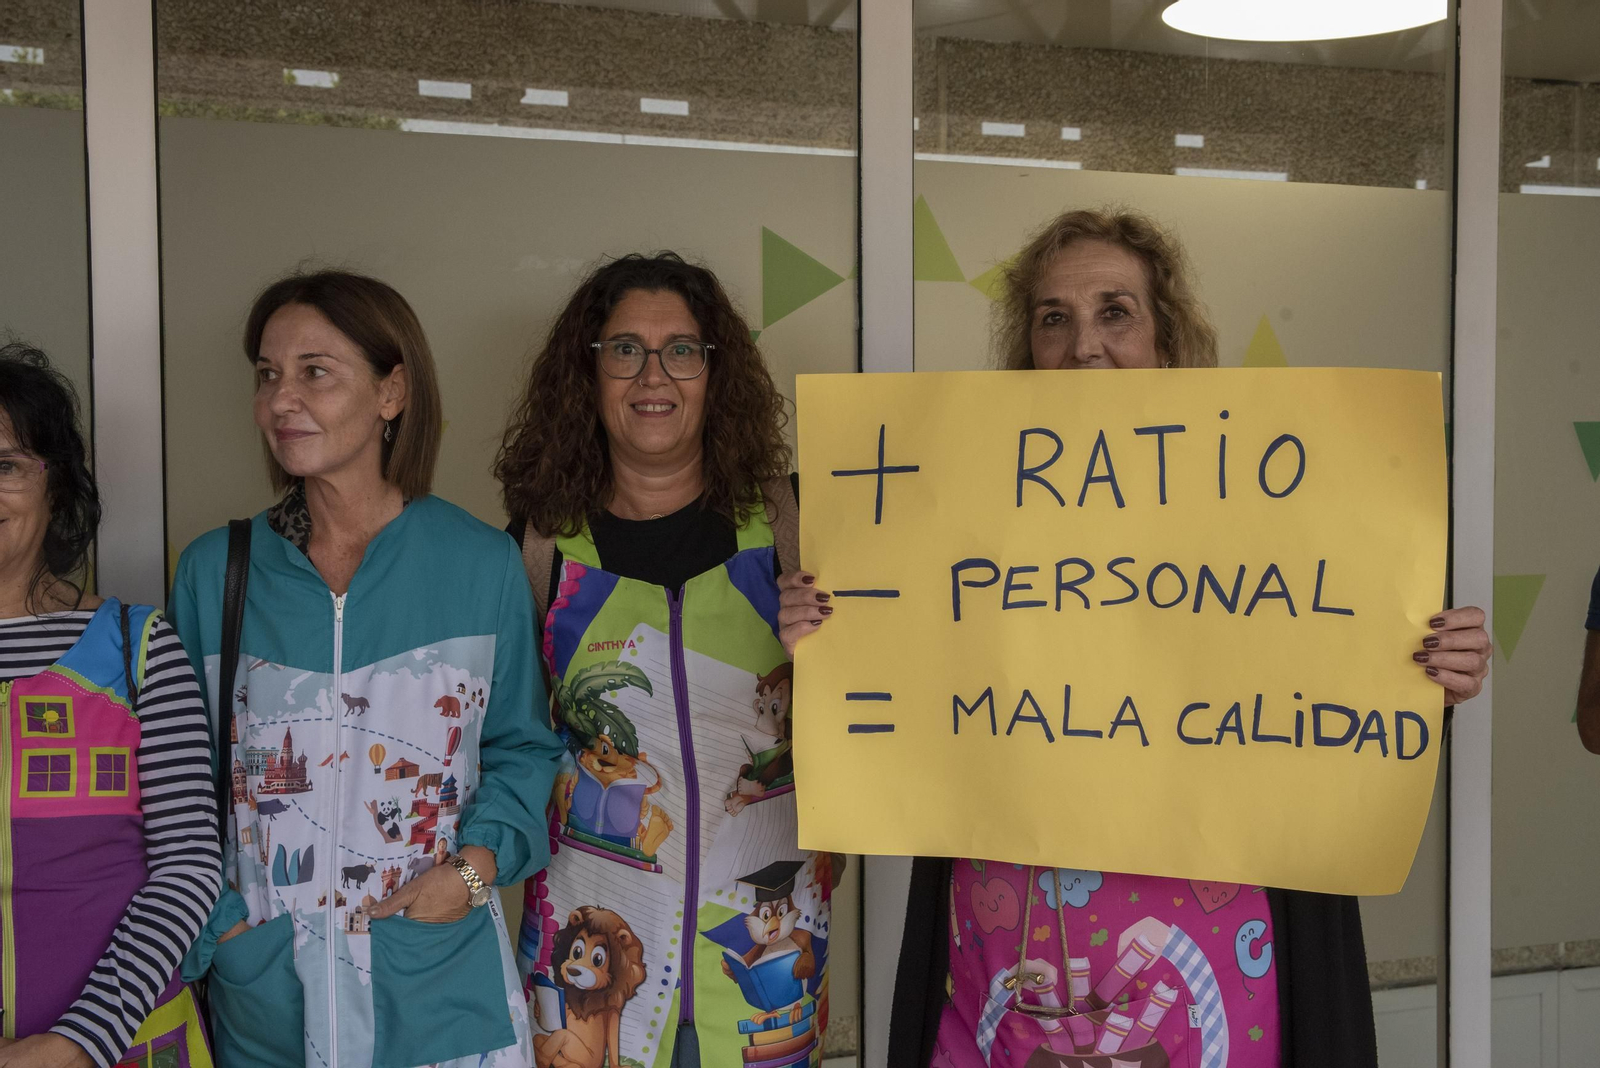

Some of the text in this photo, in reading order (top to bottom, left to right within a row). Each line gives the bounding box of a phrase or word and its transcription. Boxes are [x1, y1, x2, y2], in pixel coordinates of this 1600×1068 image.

[1017, 410, 1306, 508] RATIO
[951, 557, 1355, 622] PERSONAL
[587, 639, 636, 653] CINTHYA
[953, 685, 1150, 747] MALA
[1177, 692, 1430, 760] CALIDAD
